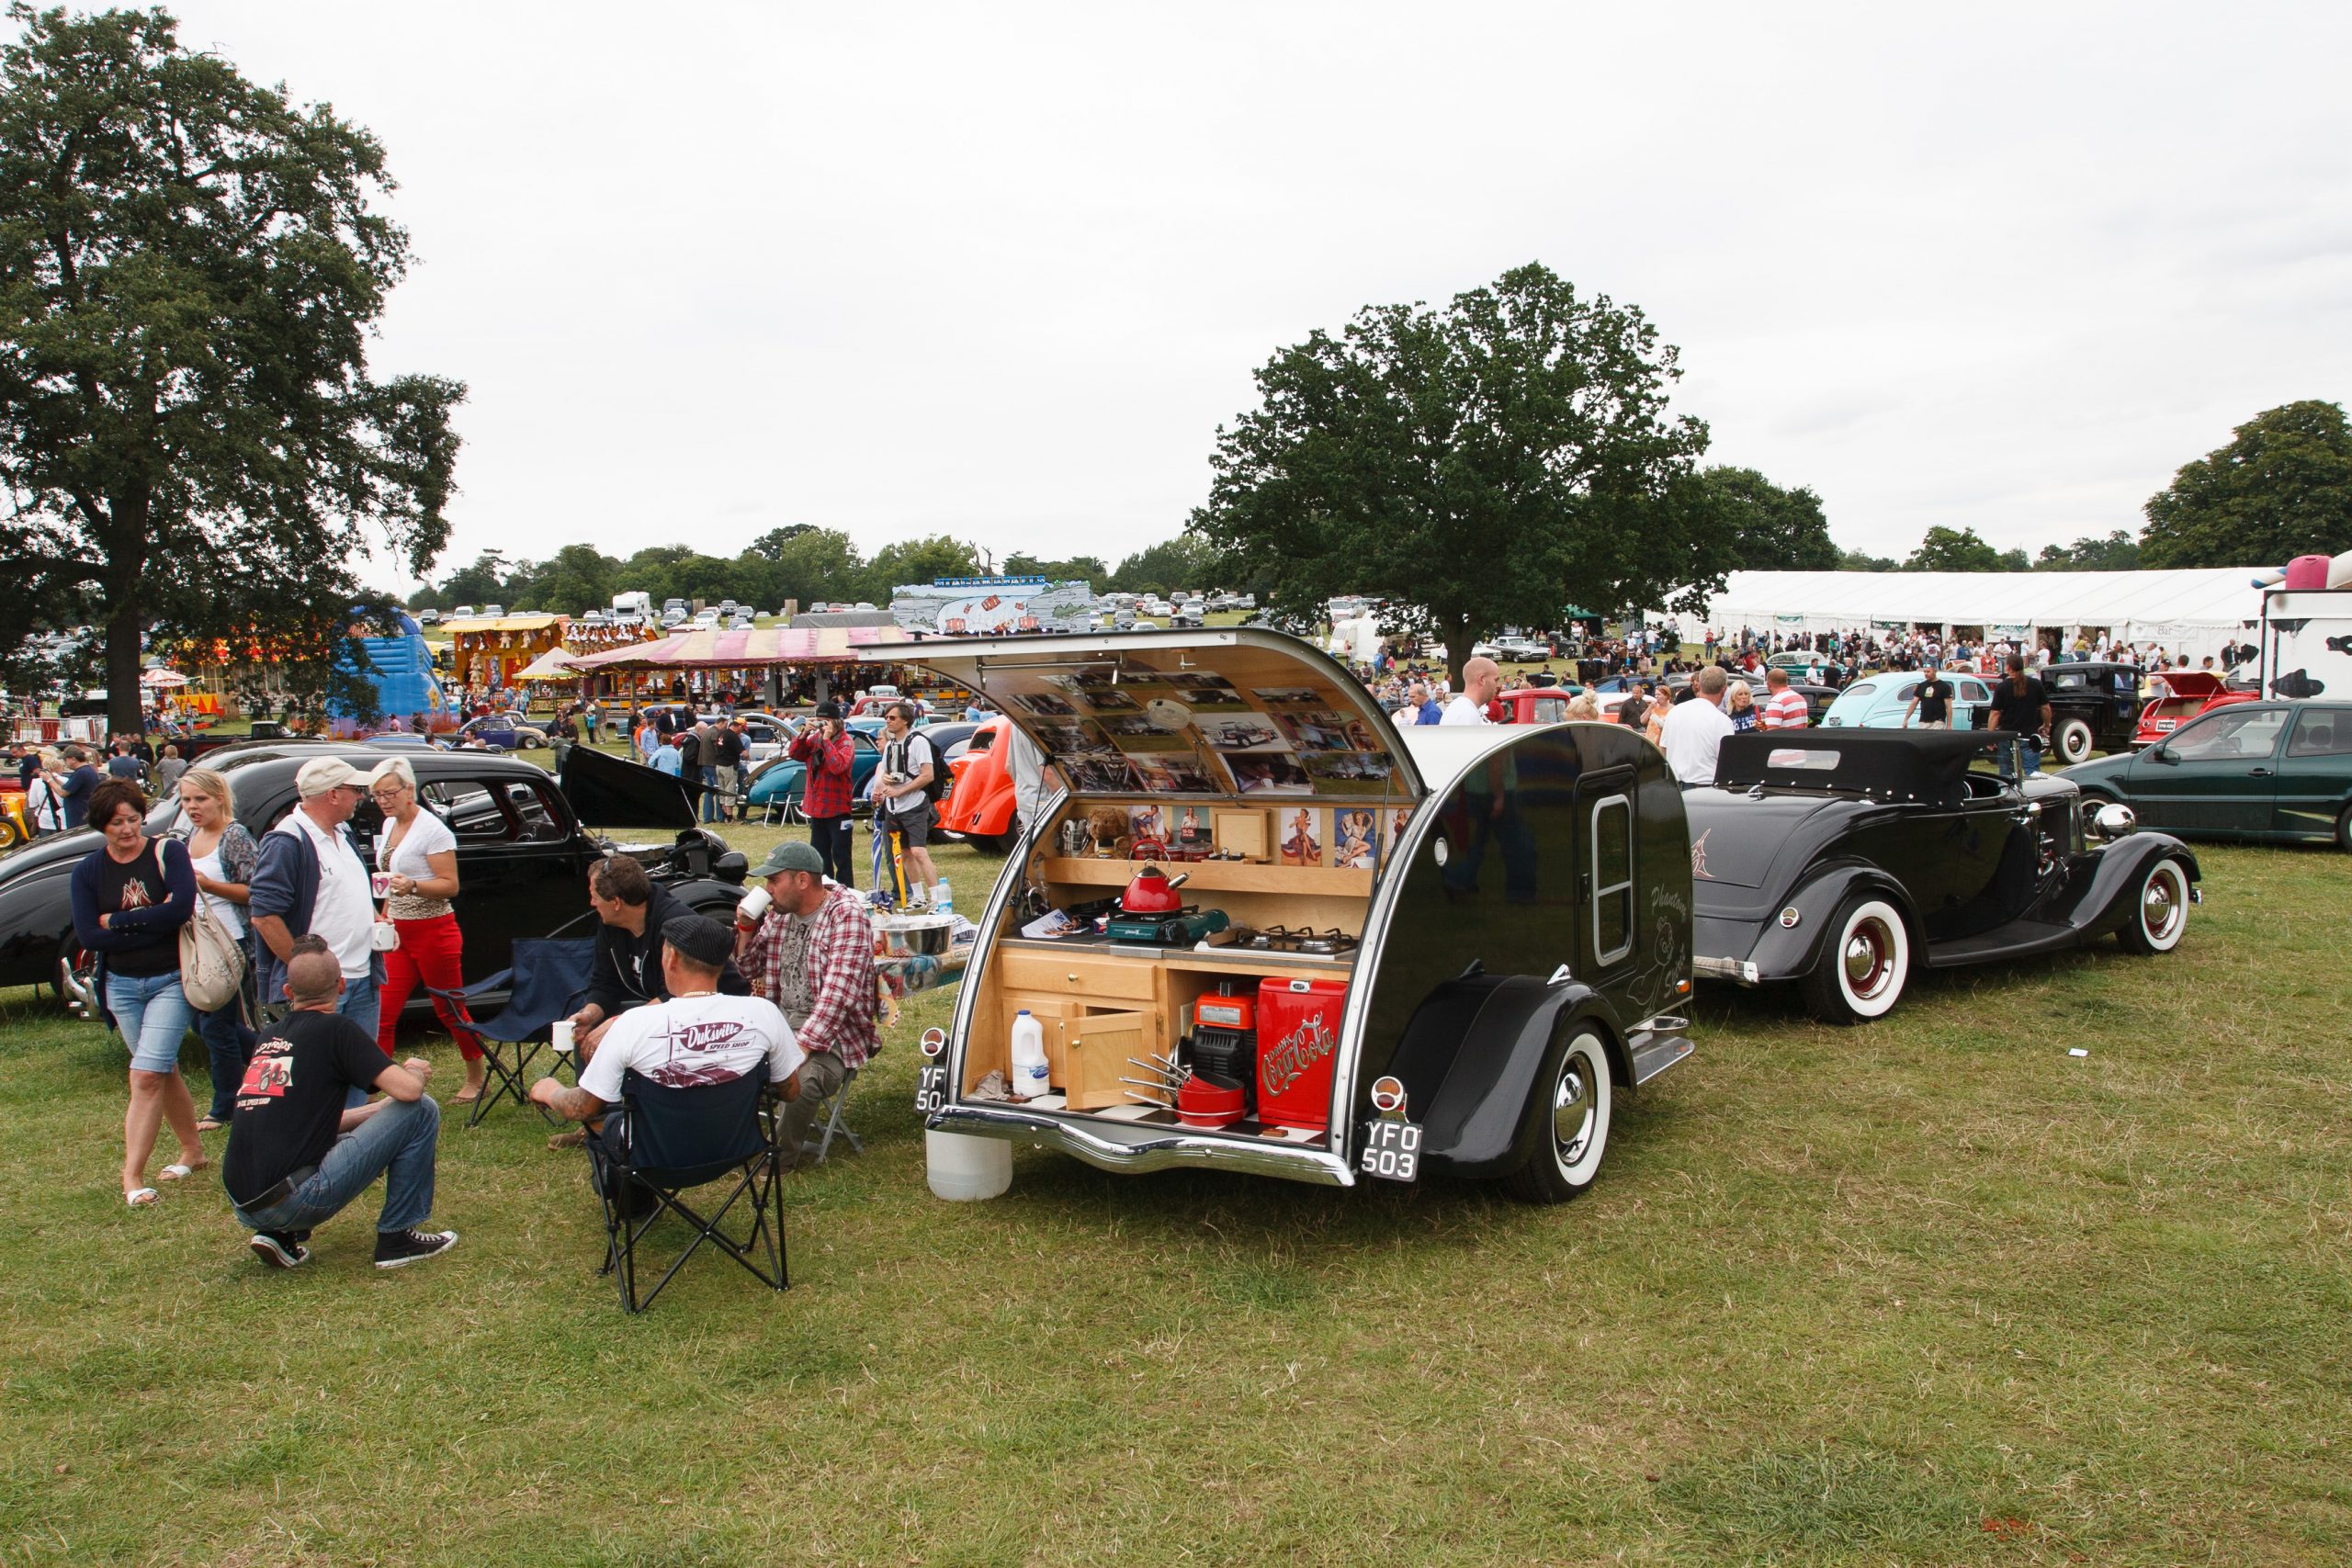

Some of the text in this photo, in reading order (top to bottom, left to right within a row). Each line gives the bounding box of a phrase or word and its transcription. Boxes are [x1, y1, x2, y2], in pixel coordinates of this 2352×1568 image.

[1651, 883, 1687, 917] Phantom
[687, 1023, 741, 1048] Duksville
[1269, 1033, 1294, 1061] DRINK
[1368, 1122, 1419, 1150] YFO
[1362, 1147, 1414, 1178] 503
